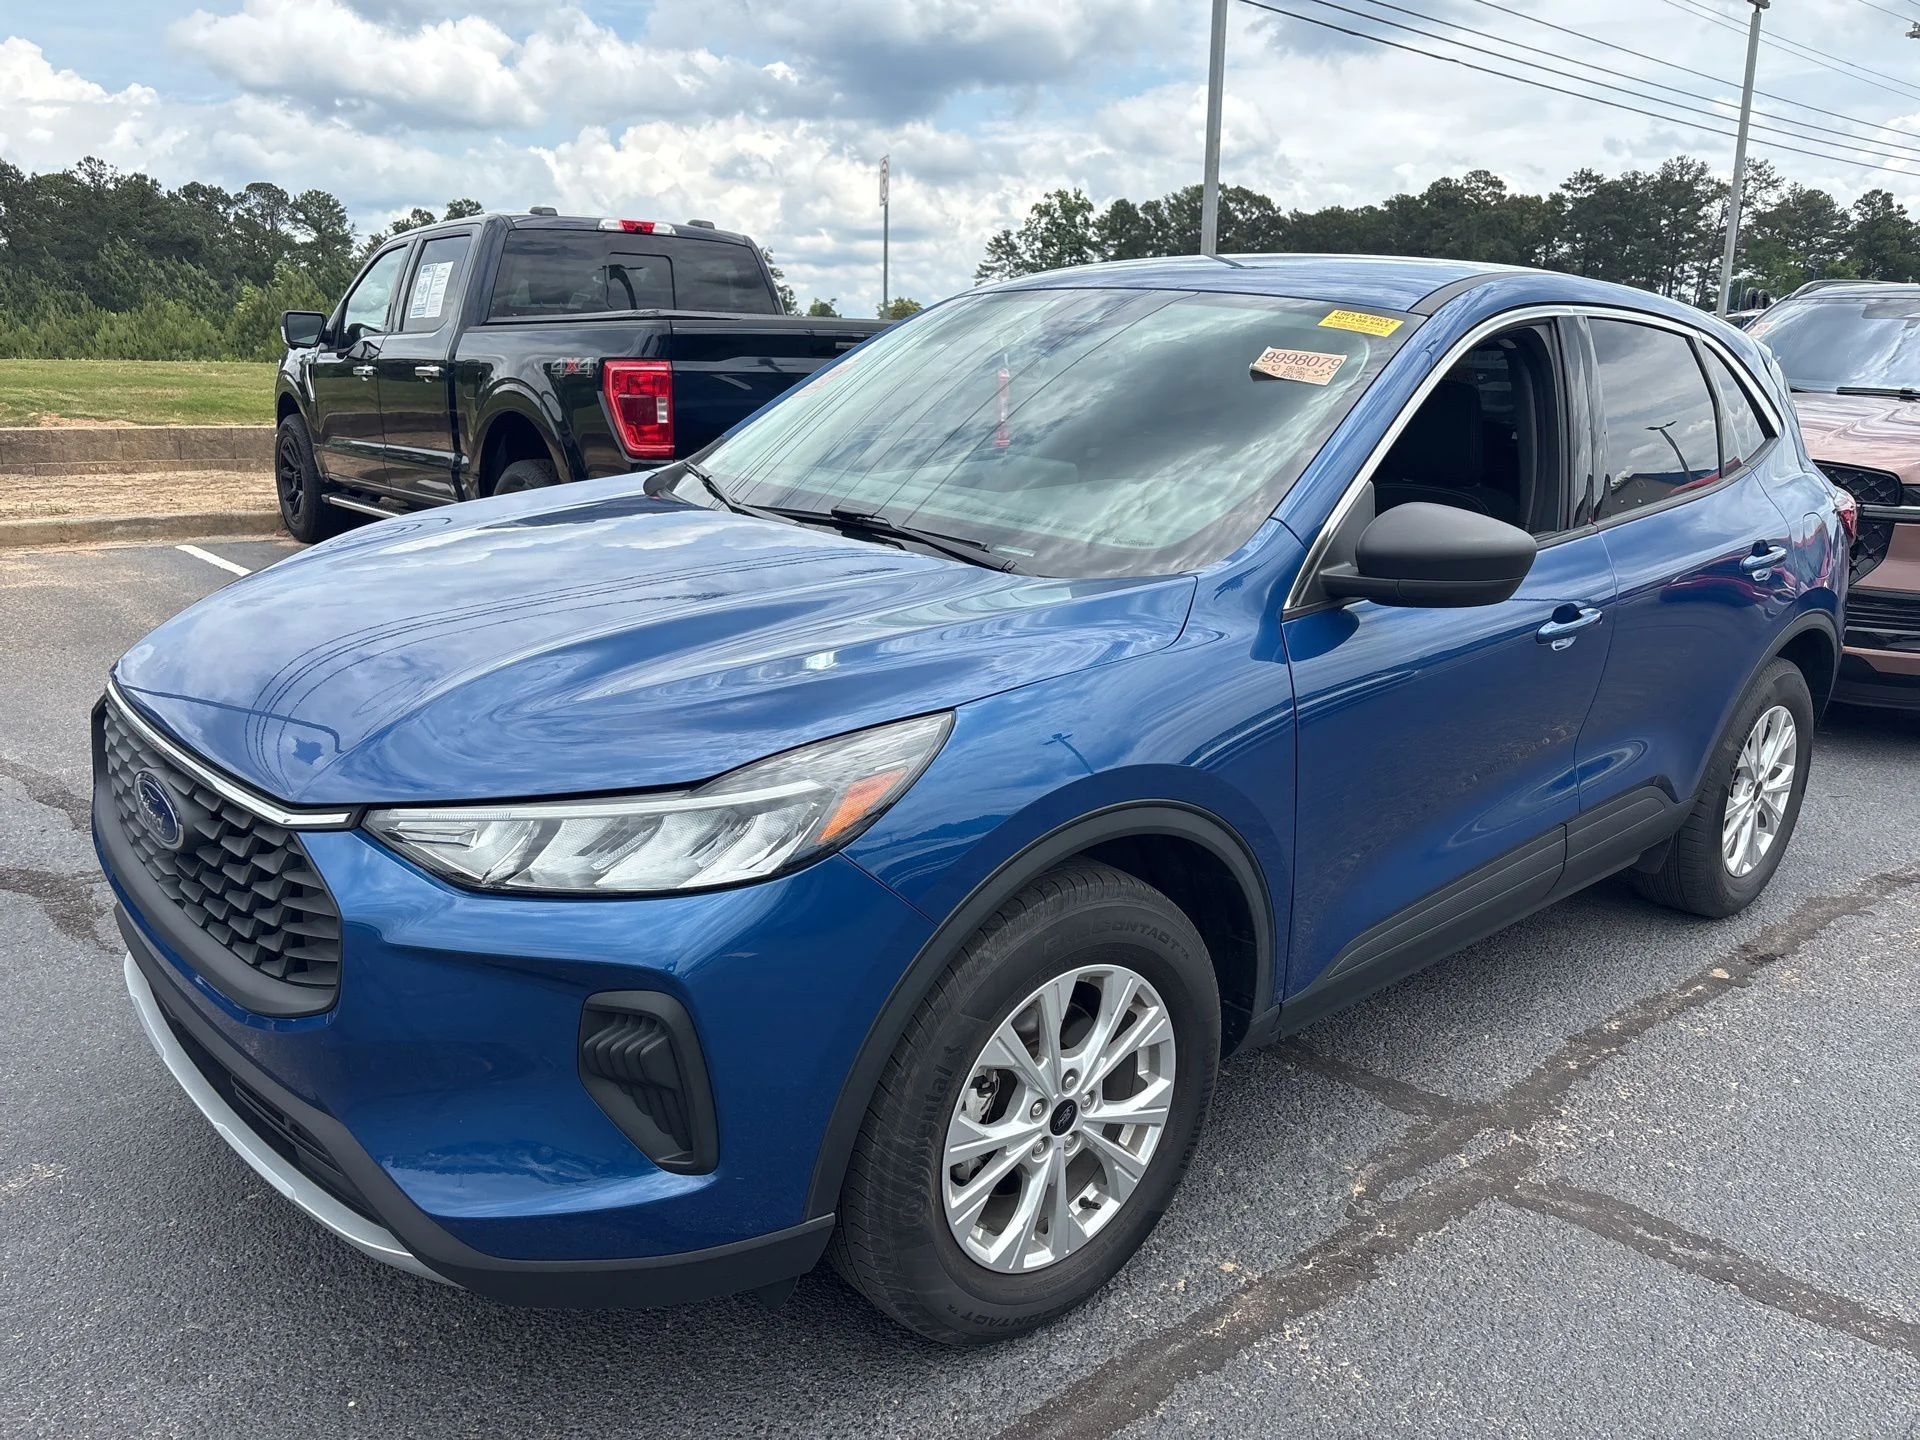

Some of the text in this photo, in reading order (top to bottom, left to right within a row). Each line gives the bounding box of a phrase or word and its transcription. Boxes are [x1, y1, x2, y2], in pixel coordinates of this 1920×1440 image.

[1358, 314, 1397, 325] VEHICLE
[1369, 320, 1390, 328] SALE
[1261, 351, 1343, 370] 9998079
